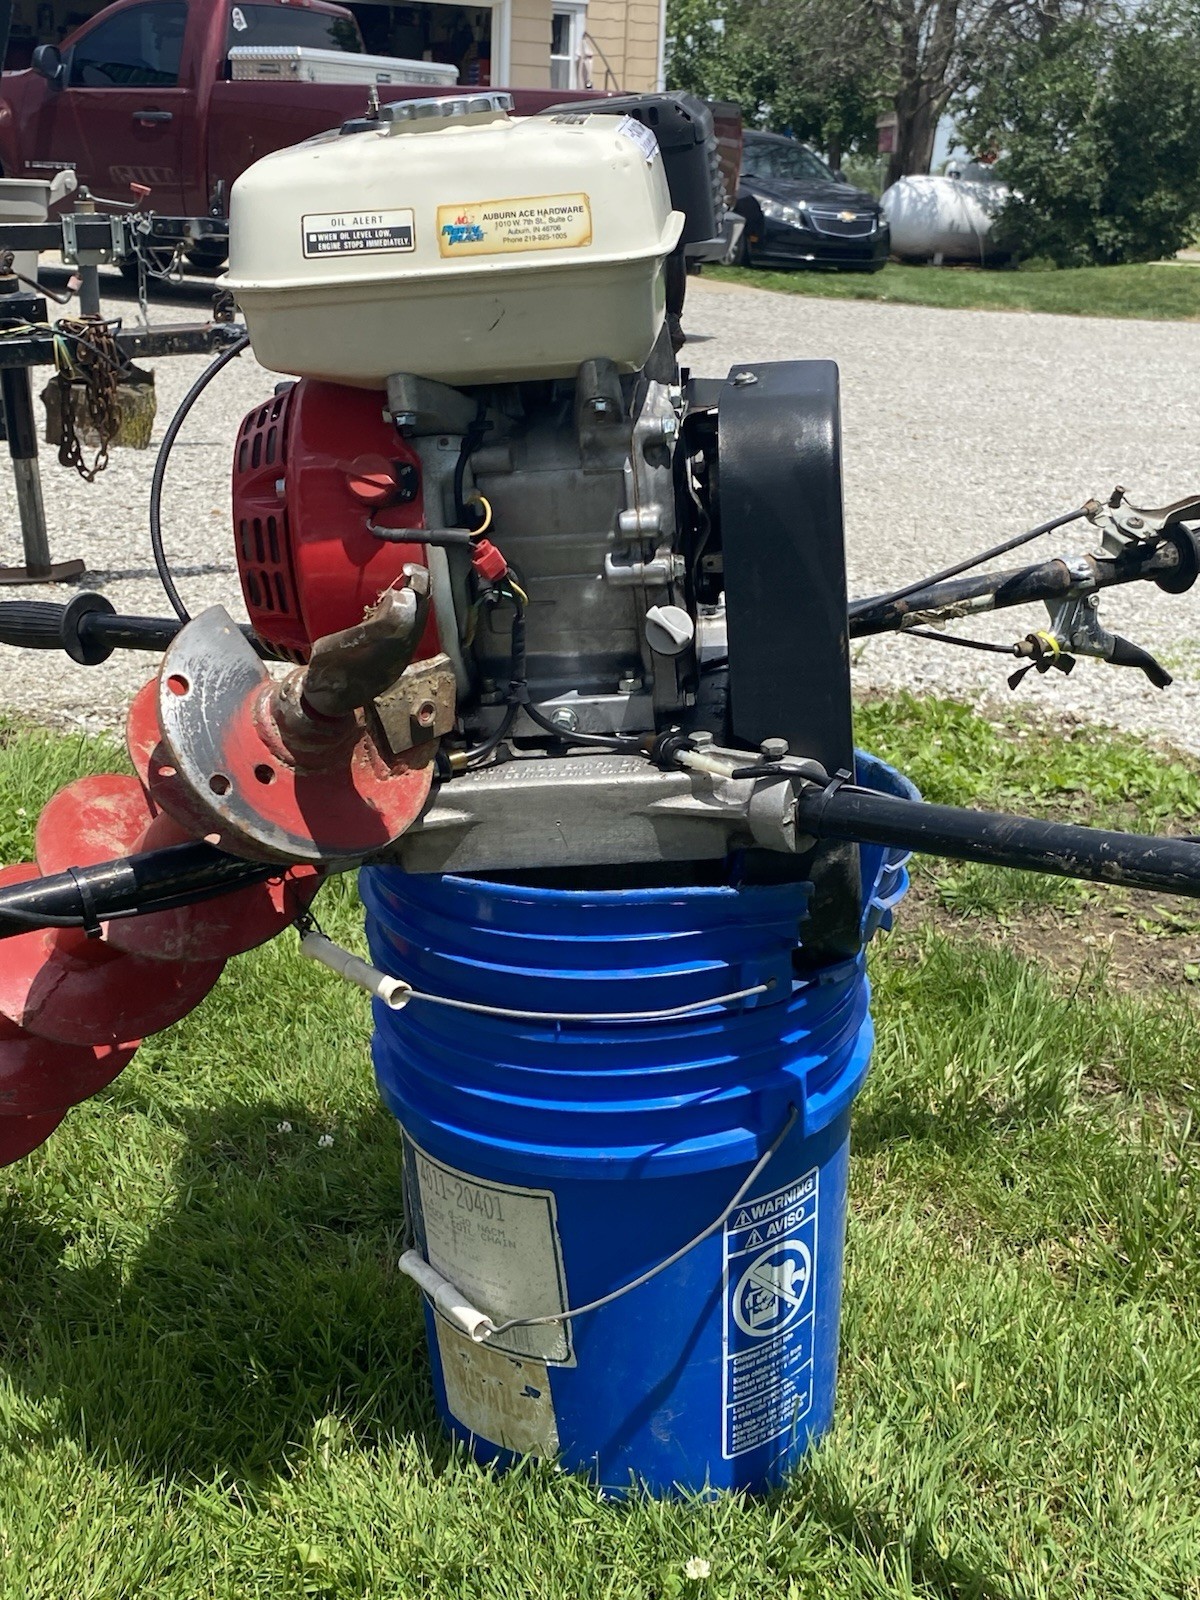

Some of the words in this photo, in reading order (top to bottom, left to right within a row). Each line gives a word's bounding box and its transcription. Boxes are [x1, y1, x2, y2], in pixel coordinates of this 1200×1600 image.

[482, 211, 517, 221] AUBURN
[518, 209, 535, 218] ACE
[537, 205, 585, 216] HARDWARE
[331, 218, 346, 227] OIL
[352, 216, 384, 226] ALERT
[523, 217, 534, 226] 7th
[548, 215, 566, 224] Suite
[566, 215, 574, 223] C
[317, 233, 338, 242] WHEN
[339, 231, 351, 240] OIL
[352, 230, 373, 240] LEVEL
[532, 226, 541, 234] IN
[318, 241, 341, 251] ENGINE
[343, 240, 364, 250] STOPS
[503, 236, 523, 244] Phone
[420, 1159, 505, 1222] 4011-20401
[750, 1177, 814, 1221] WARNING
[766, 1206, 805, 1239] AVISO
[480, 1232, 517, 1249] CHAIN
